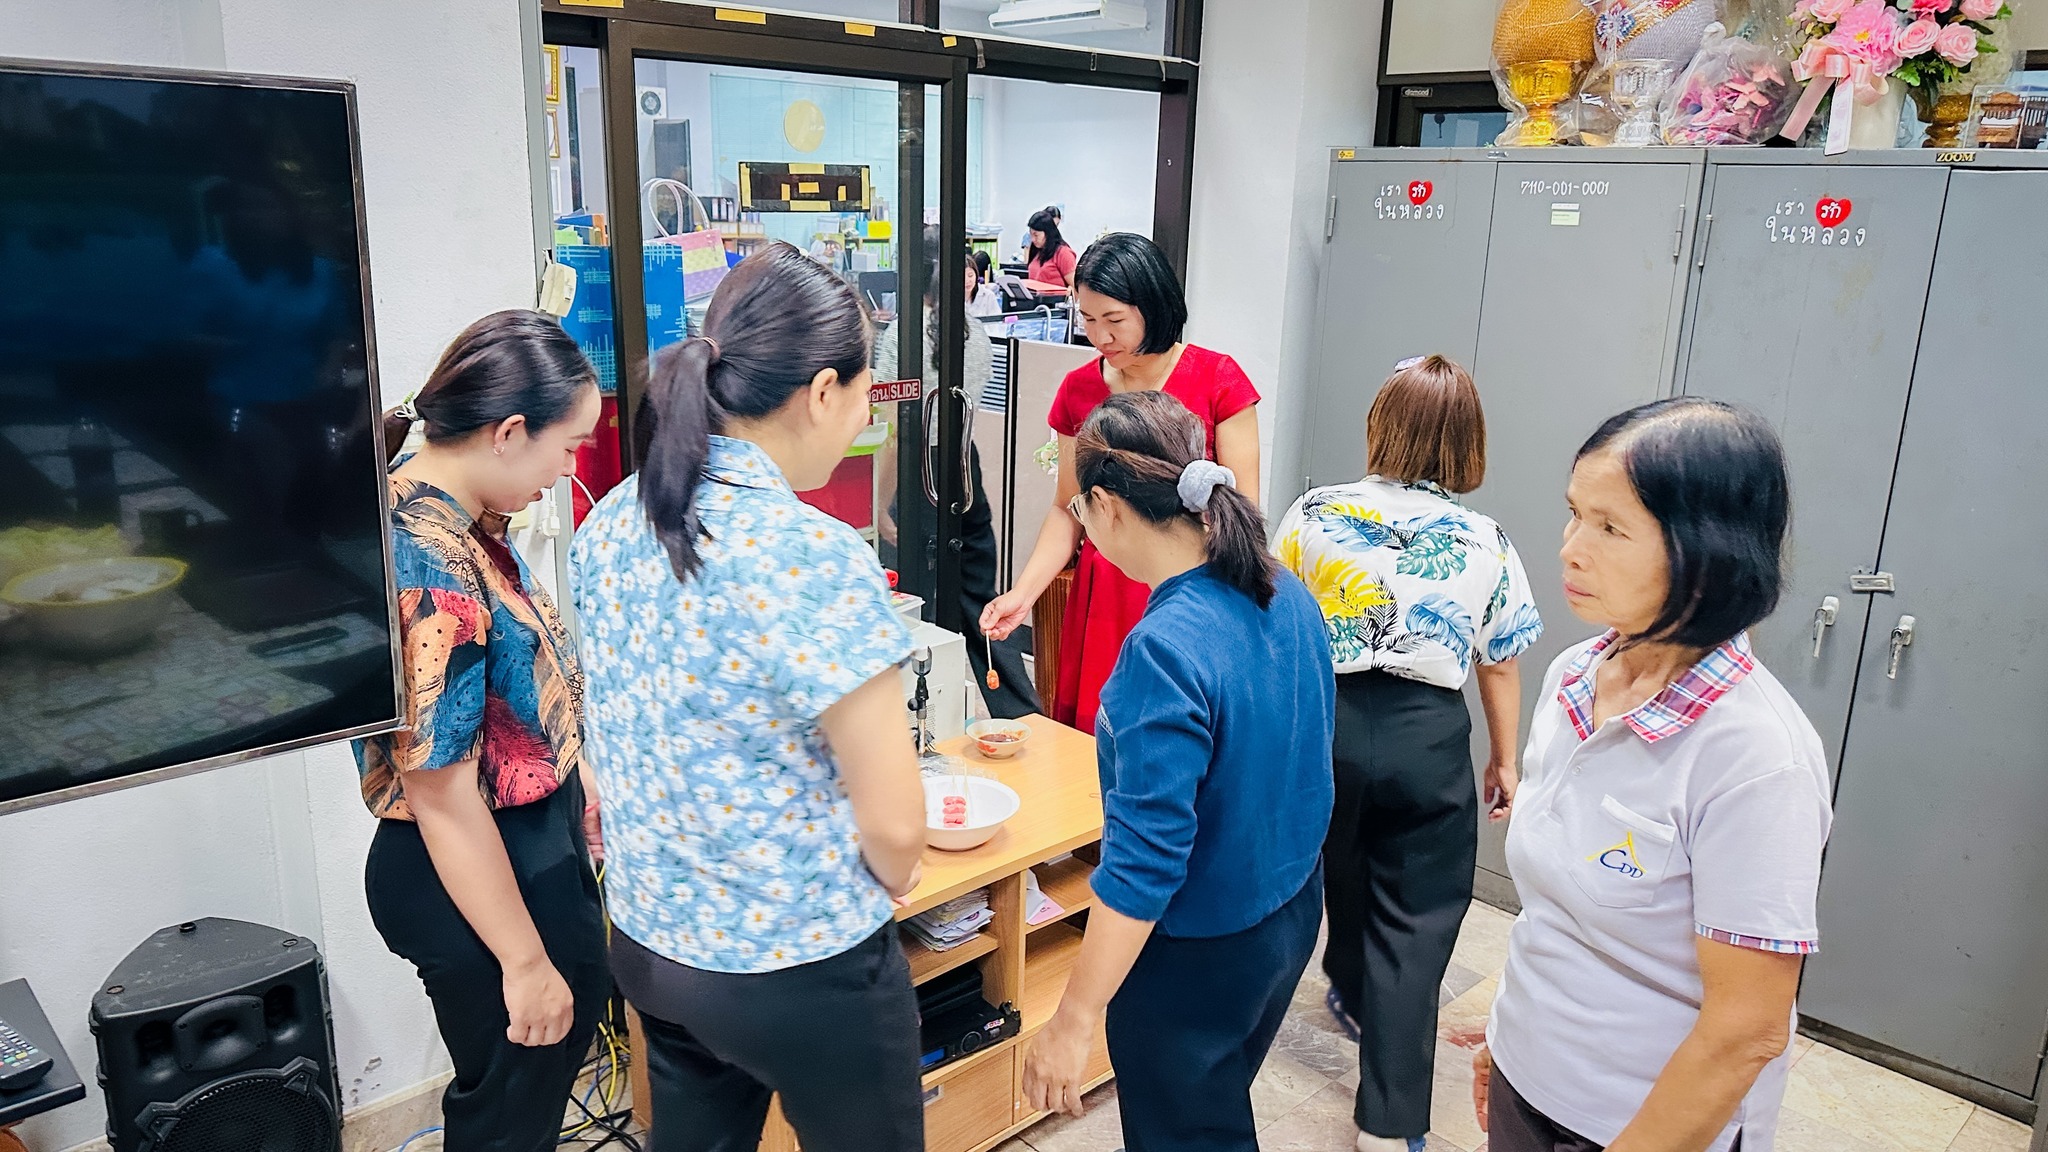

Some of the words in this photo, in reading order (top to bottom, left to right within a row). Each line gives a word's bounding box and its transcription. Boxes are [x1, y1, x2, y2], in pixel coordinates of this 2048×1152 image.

[1936, 151, 1976, 162] ZOOM
[1380, 184, 1401, 197] เรา
[1520, 180, 1610, 196] 7110-001-0001
[1374, 197, 1445, 220] ในหลวง
[1775, 201, 1805, 216] เรา
[1765, 215, 1866, 247] ในหลวง
[890, 382, 919, 400] SLIDE
[1599, 848, 1644, 879] CDD
